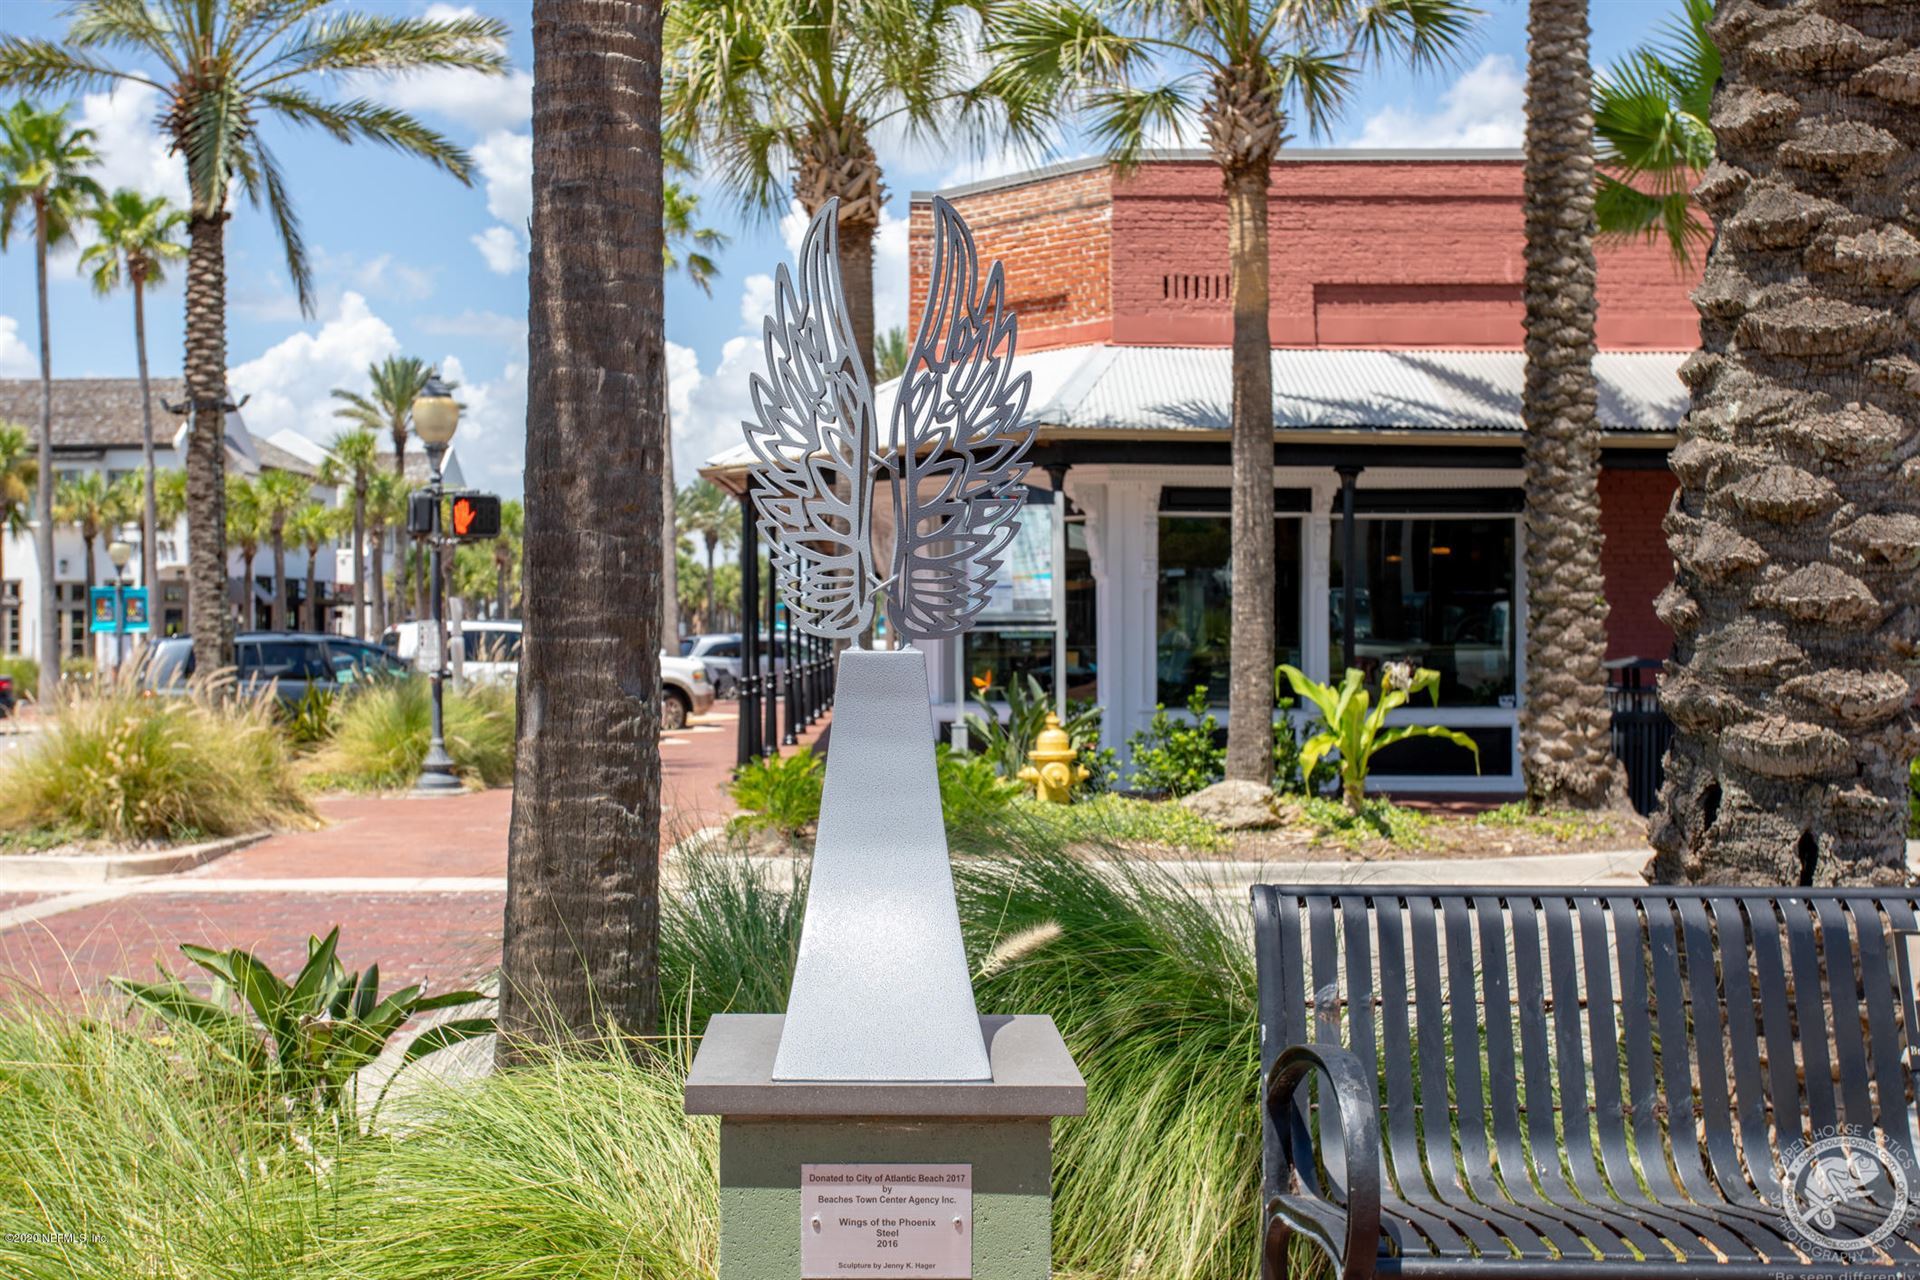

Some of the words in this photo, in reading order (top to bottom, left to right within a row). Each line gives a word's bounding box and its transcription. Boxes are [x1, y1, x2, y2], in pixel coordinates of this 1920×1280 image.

[809, 1174, 844, 1182] Donated
[846, 1174, 854, 1182] to
[856, 1174, 872, 1184] City
[875, 1174, 883, 1182] of
[885, 1174, 916, 1182] Atlantic
[918, 1174, 944, 1182] Beach
[946, 1174, 965, 1182] 2017
[882, 1185, 892, 1194] by
[908, 1196, 939, 1205] Agency
[839, 1218, 868, 1228] Wings
[870, 1218, 880, 1226] of
[881, 1218, 896, 1226] the
[899, 1218, 936, 1226] Phoenix
[876, 1229, 899, 1237] Steel
[876, 1240, 898, 1248] 2016
[838, 1262, 871, 1270] Sculpture
[873, 1262, 882, 1270] by
[883, 1262, 904, 1270] Jenny
[915, 1262, 936, 1270] Hager
